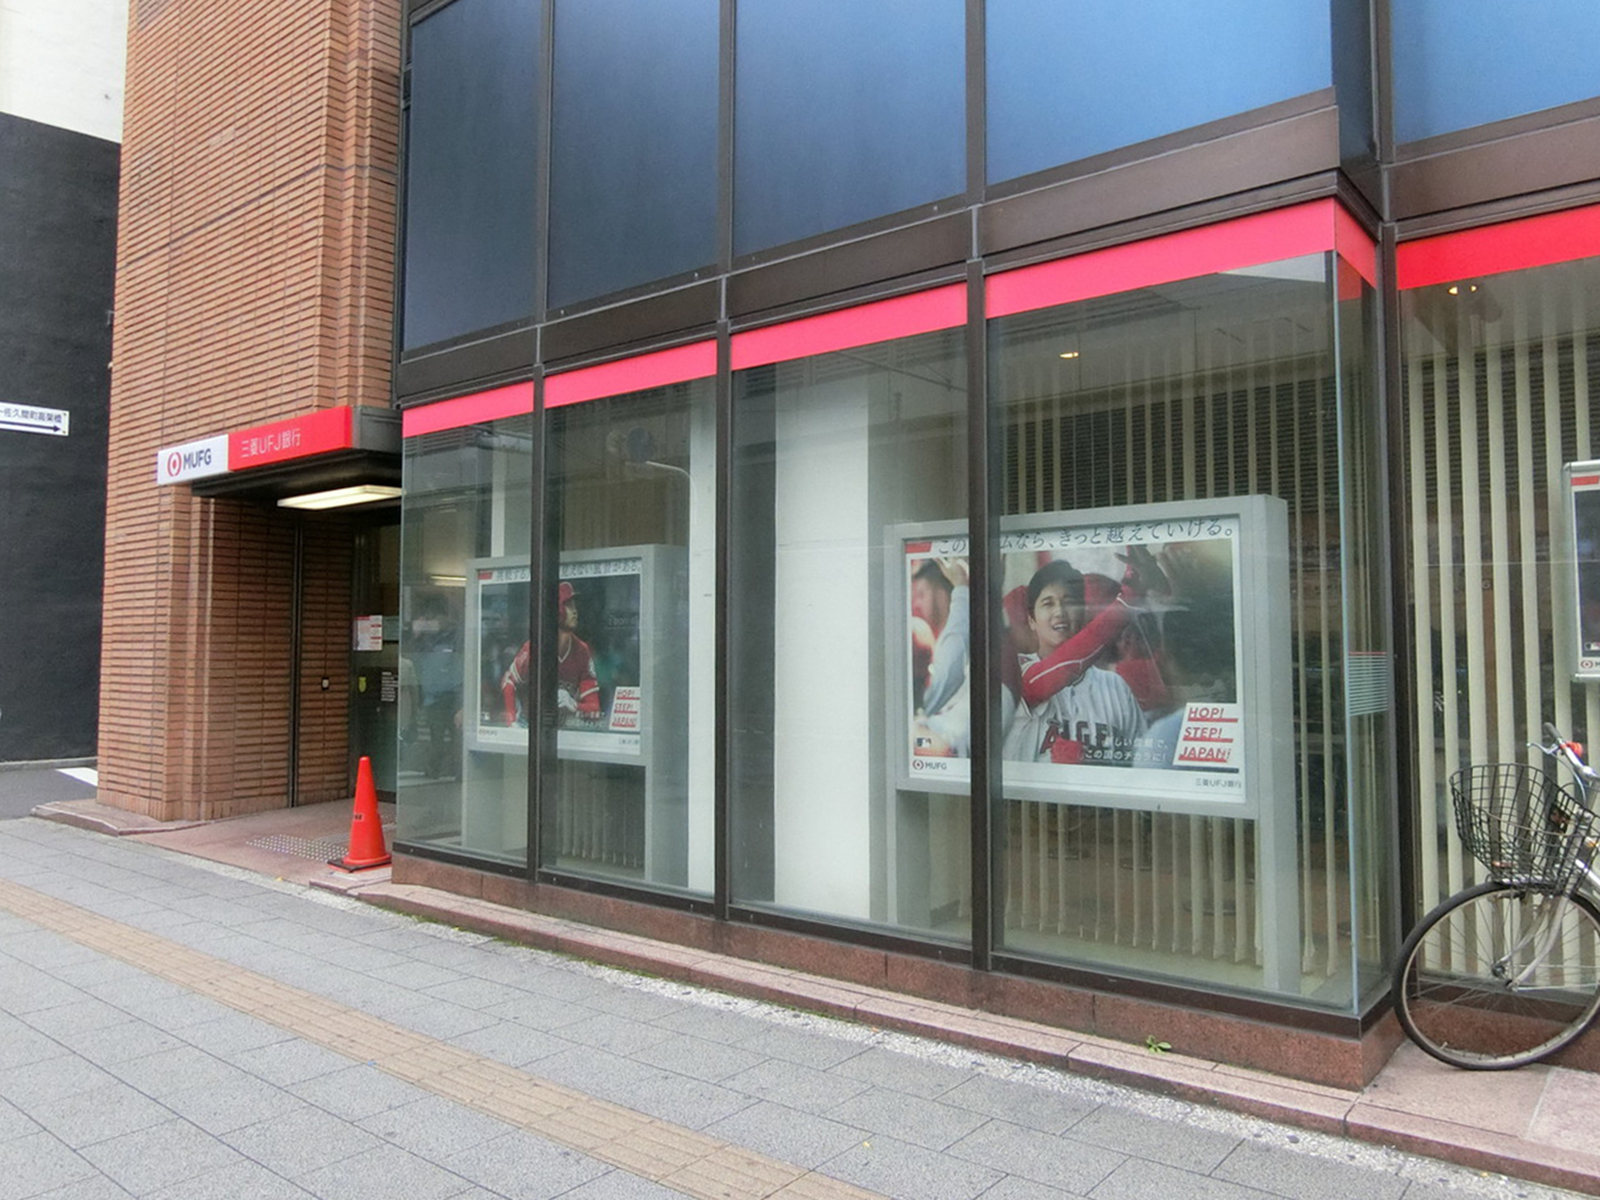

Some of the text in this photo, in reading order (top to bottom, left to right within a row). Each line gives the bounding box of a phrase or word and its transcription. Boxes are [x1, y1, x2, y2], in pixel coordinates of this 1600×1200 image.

[241, 428, 302, 459] 三菱UFJ銀行
[183, 448, 212, 471] MUFG
[1188, 707, 1225, 719] HOP!
[1184, 727, 1223, 739] STEP!
[1179, 746, 1232, 760] JAPAN!
[925, 761, 948, 771] MUFG
